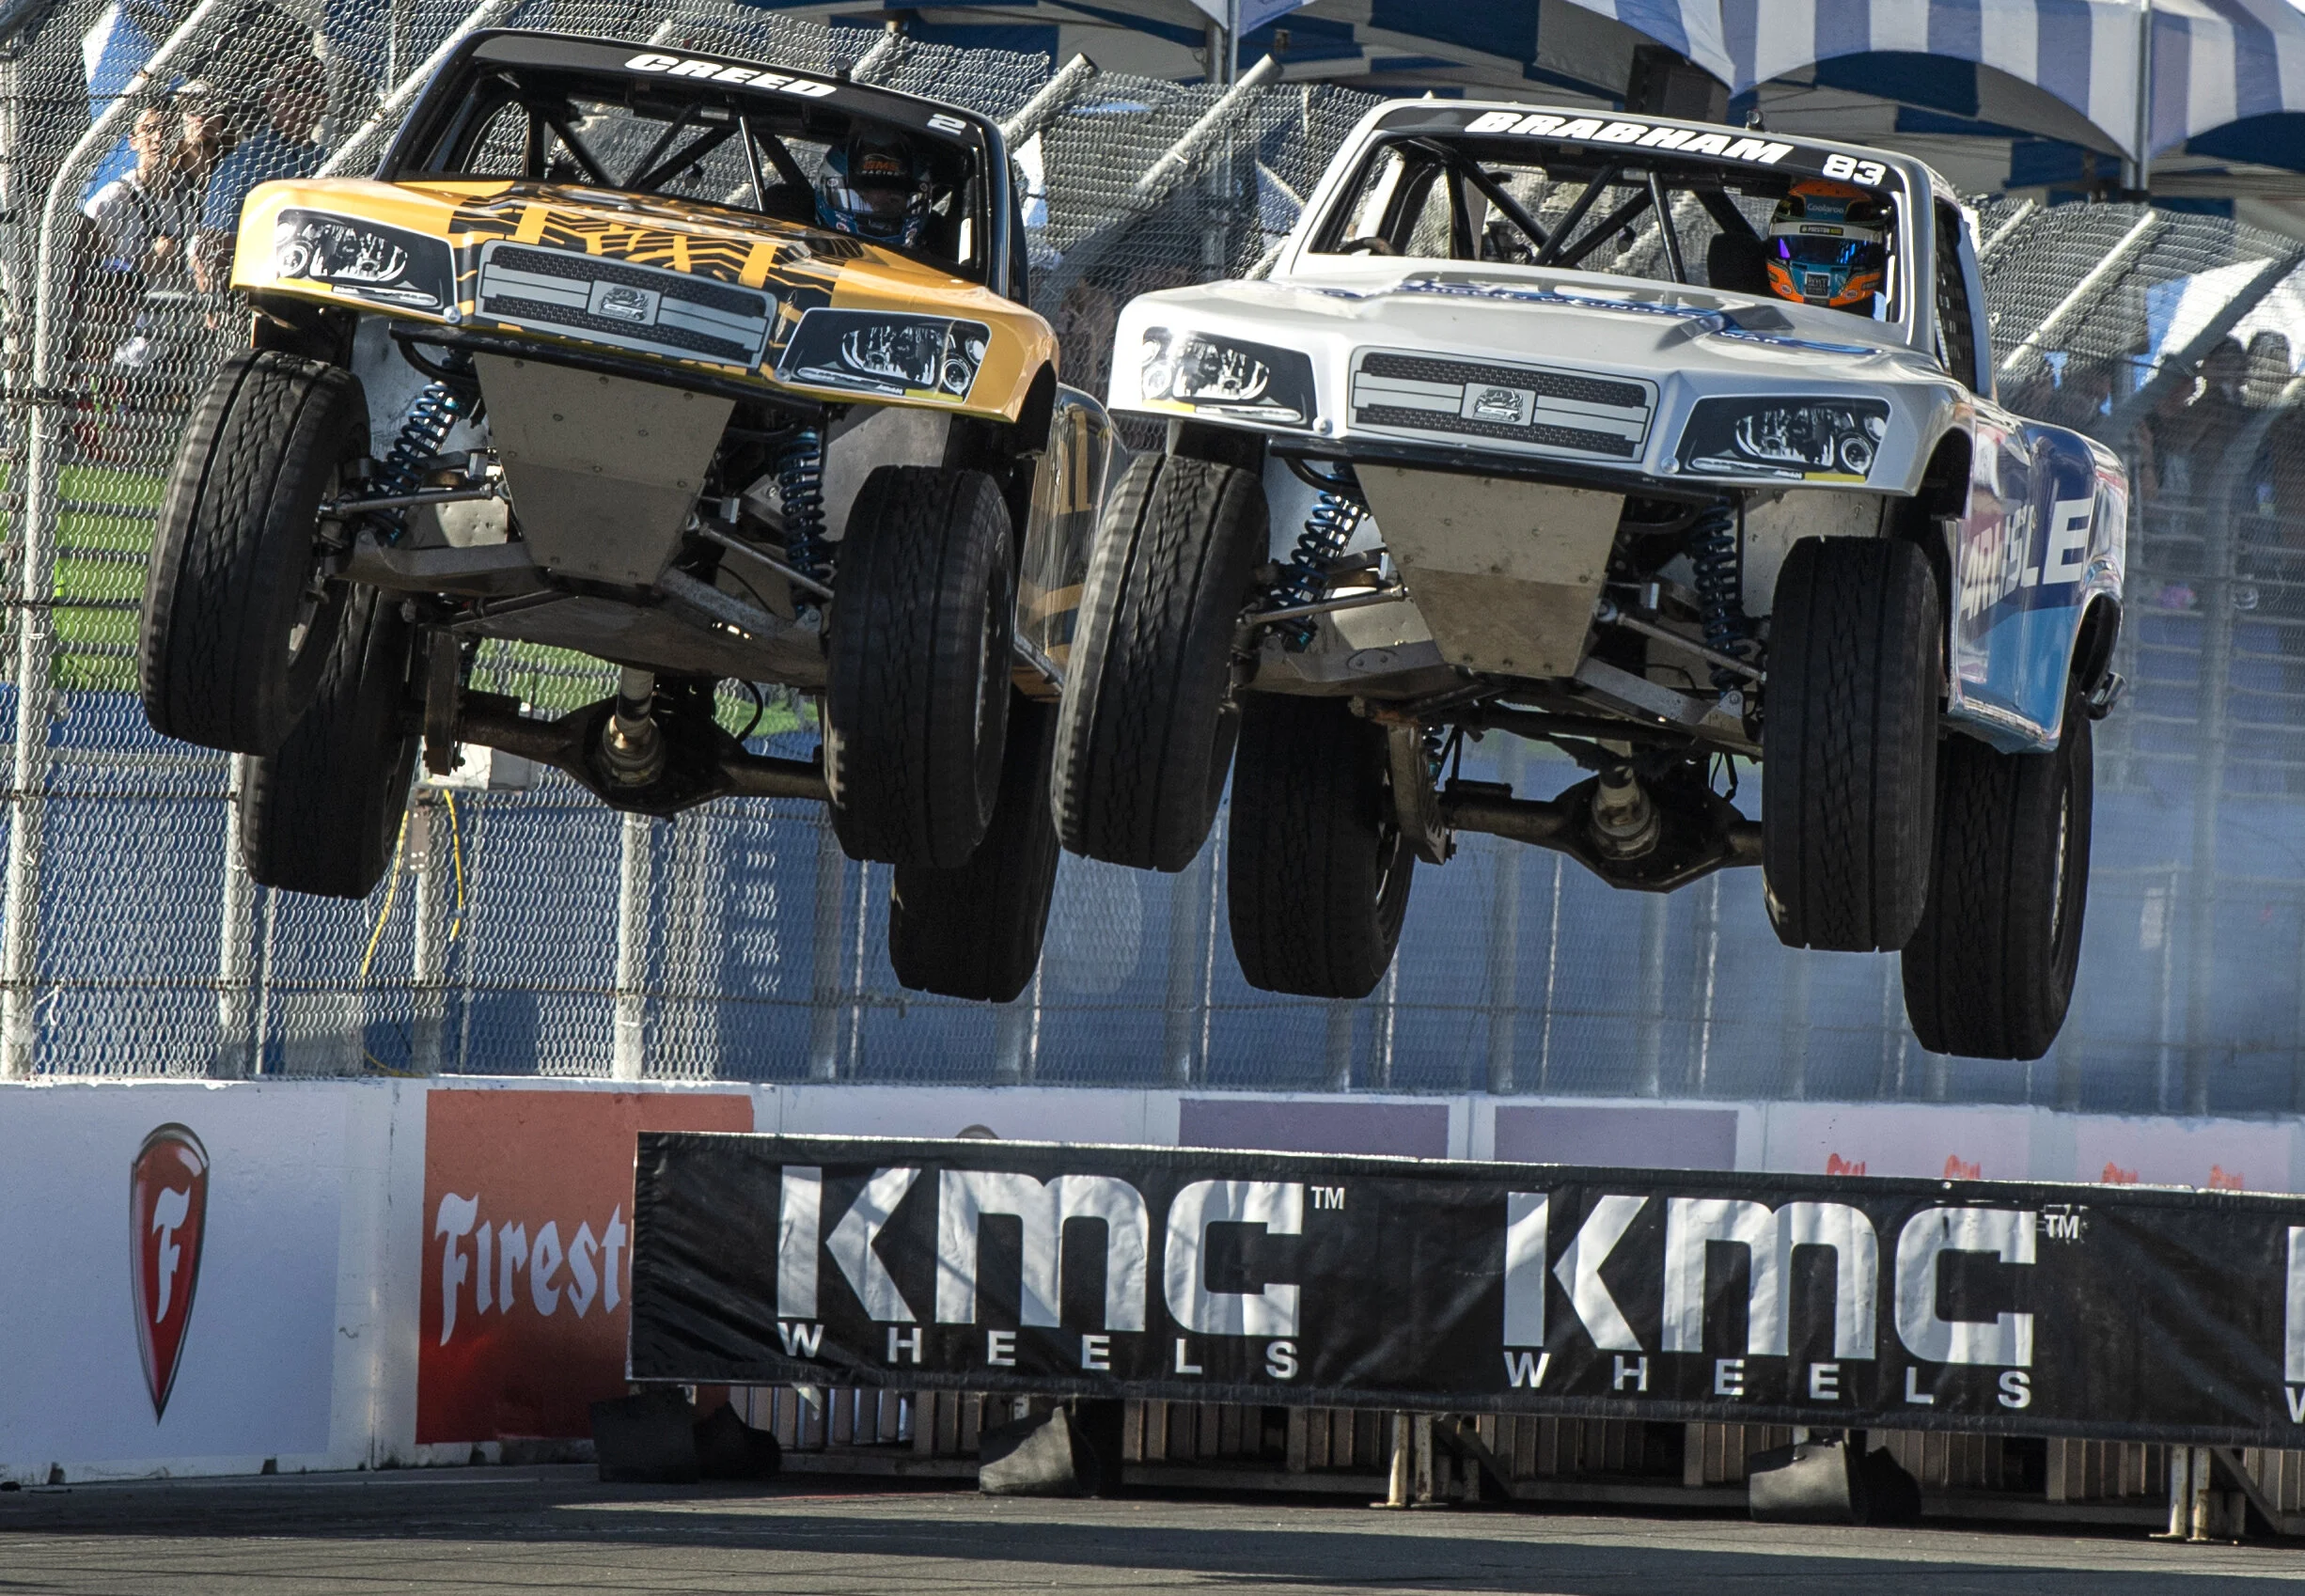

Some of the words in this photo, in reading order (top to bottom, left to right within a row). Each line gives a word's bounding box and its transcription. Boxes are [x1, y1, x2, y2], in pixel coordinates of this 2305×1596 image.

[624, 54, 837, 97] CREED
[926, 113, 966, 135] 2
[1464, 111, 1795, 164] BRABHAM
[1822, 153, 1888, 186] 83
[1806, 202, 1845, 214] Coolaroo
[434, 1191, 627, 1347] Firest
[777, 1321, 1300, 1380] WHEELS
[1504, 1353, 2032, 1408] WHEELS
